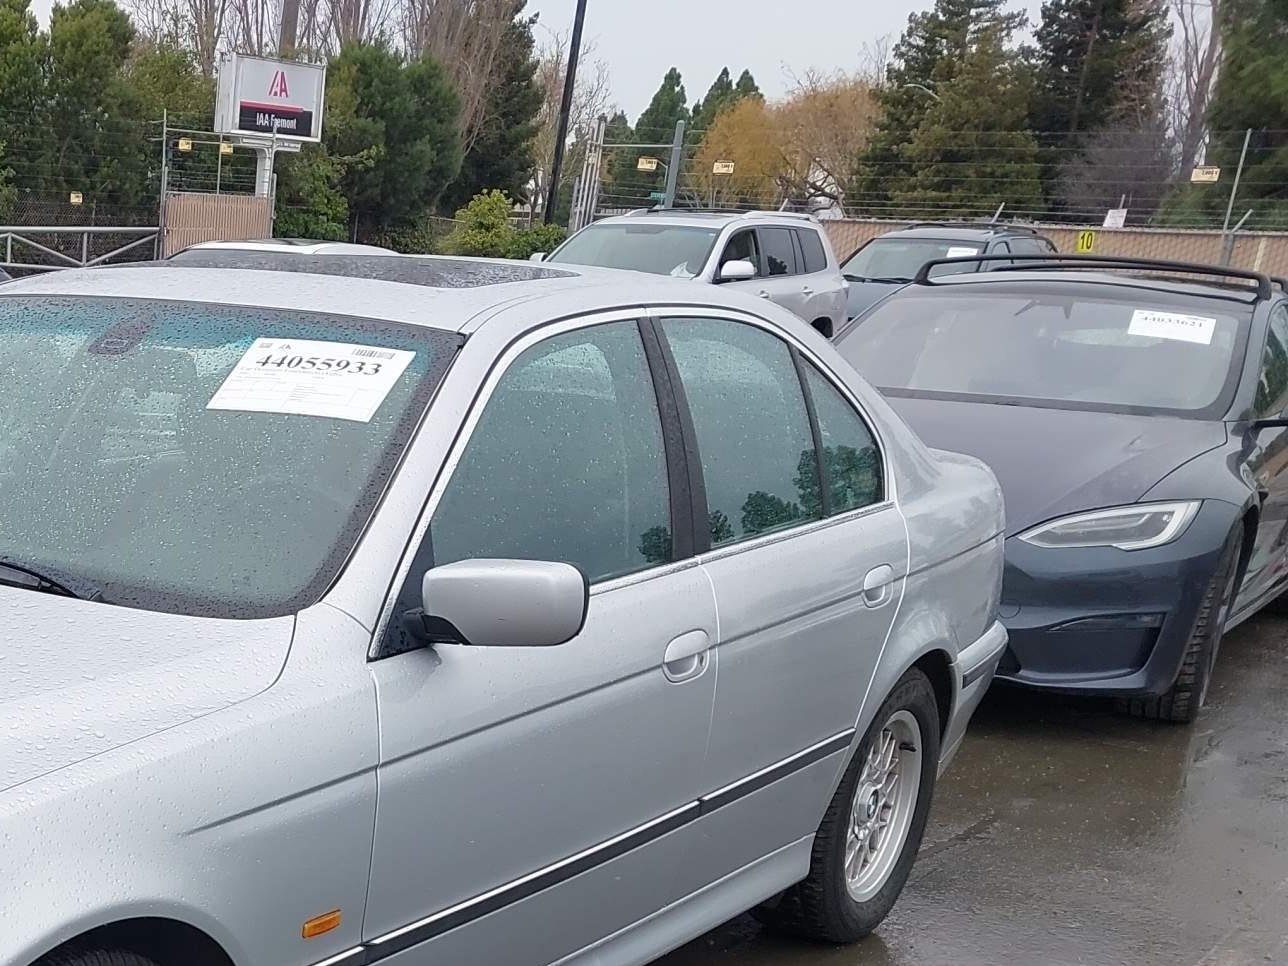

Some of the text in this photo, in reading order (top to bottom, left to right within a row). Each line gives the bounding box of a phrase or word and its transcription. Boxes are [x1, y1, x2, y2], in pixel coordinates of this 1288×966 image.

[256, 112, 270, 127] IAA
[1080, 232, 1093, 250] 10
[255, 354, 383, 376] 44055933
